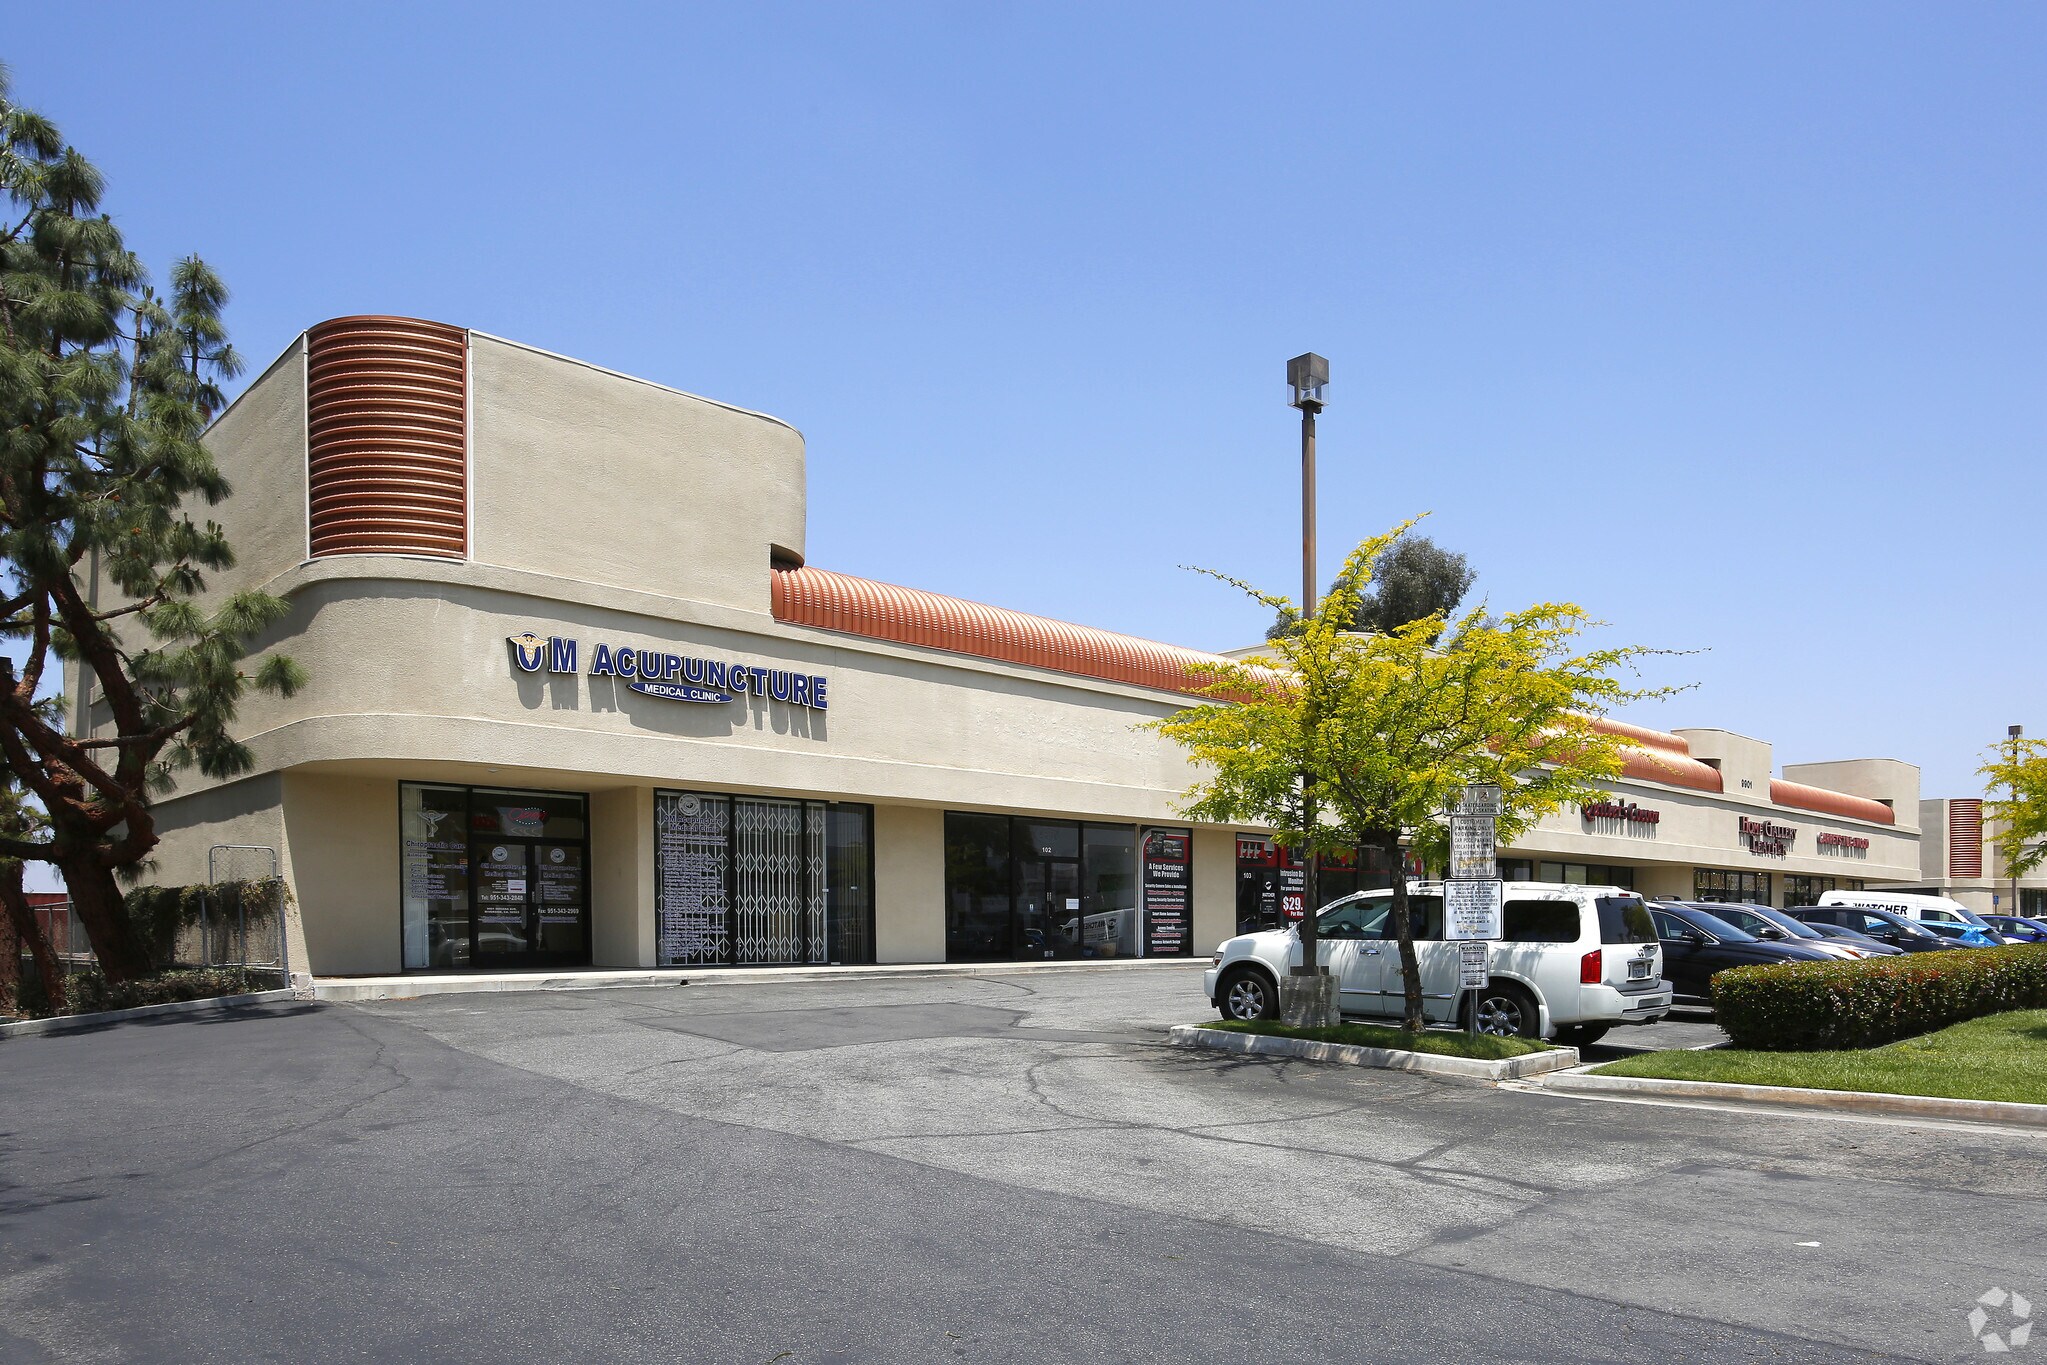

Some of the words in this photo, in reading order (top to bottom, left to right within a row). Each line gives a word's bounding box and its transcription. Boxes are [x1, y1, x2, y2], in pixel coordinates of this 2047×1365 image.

[512, 631, 578, 674] OM
[591, 642, 829, 711] ACUPUNCTURE
[644, 683, 687, 698] MEDICAL
[690, 688, 721, 702] CLINIC
[678, 816, 722, 825] Acupuncture
[1764, 820, 1798, 840] GALLERY
[406, 840, 449, 849] Chiropractic
[1749, 836, 1787, 856] LEATHER
[1163, 863, 1184, 871] Services
[1283, 895, 1303, 911] $29.
